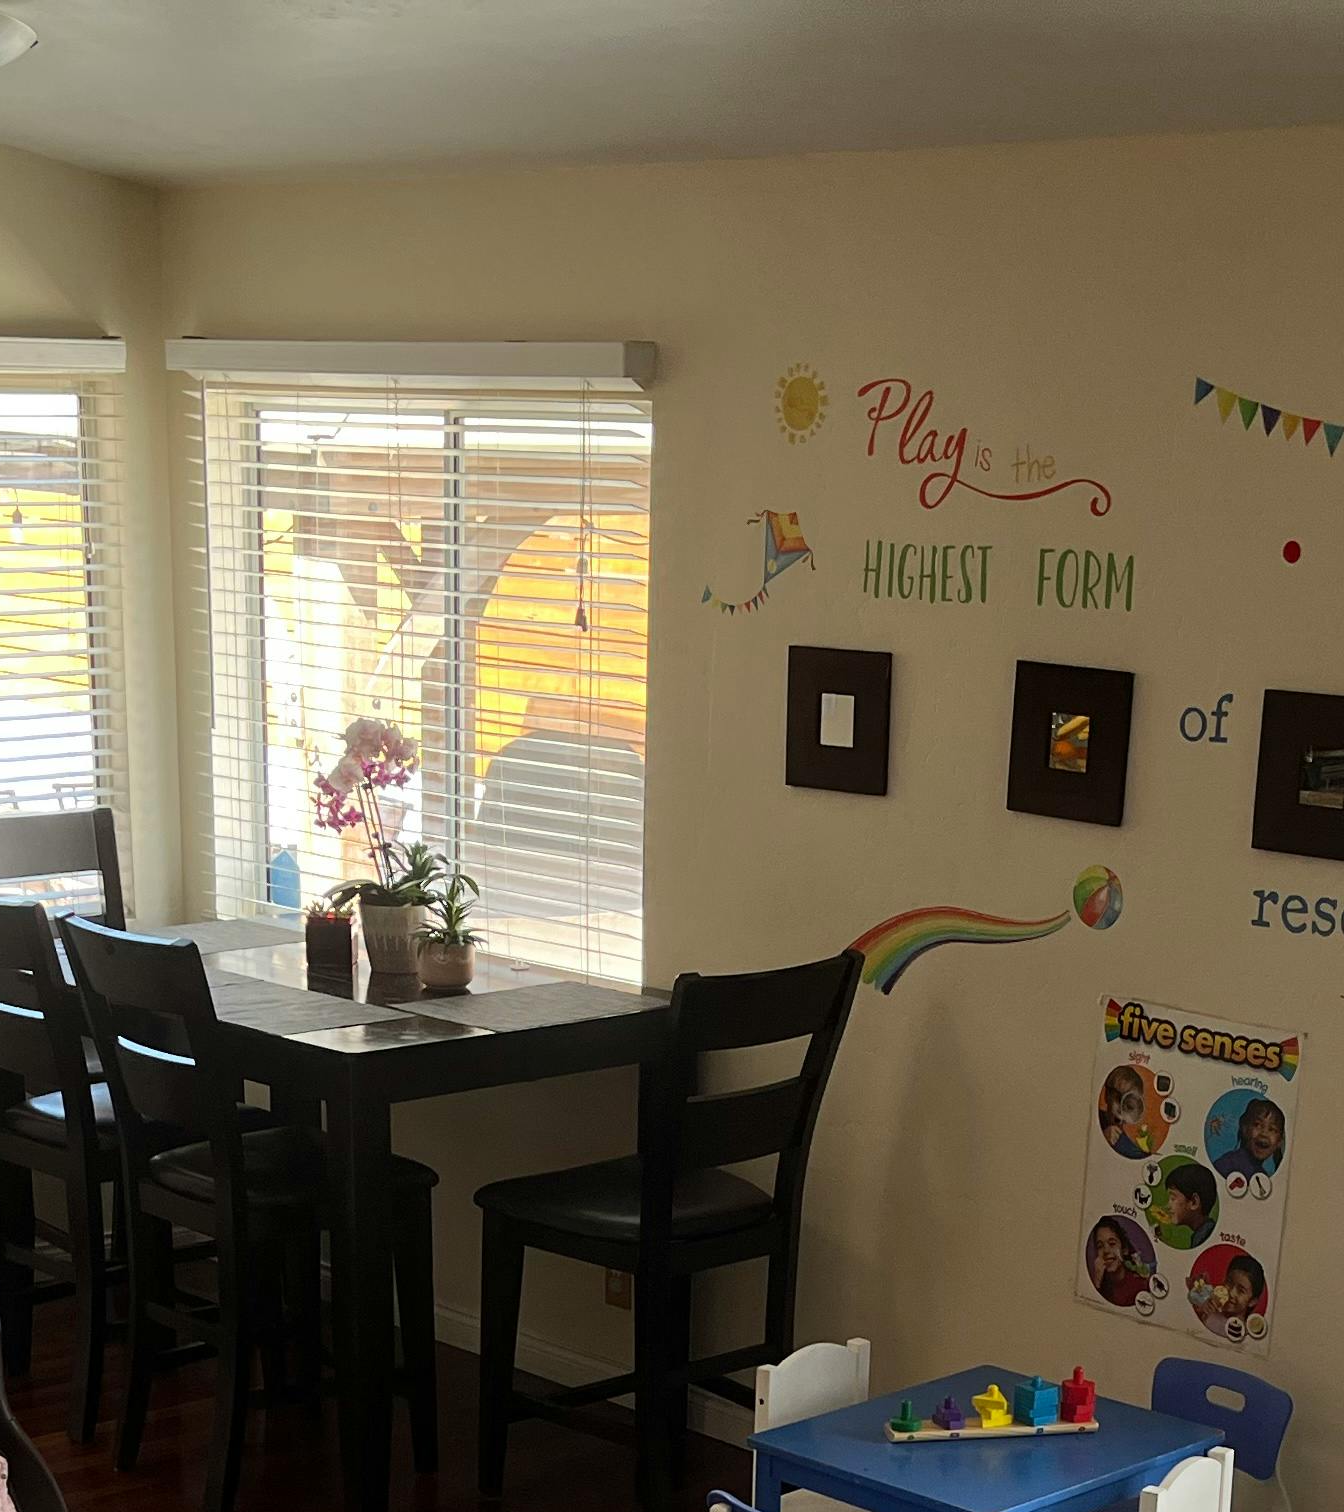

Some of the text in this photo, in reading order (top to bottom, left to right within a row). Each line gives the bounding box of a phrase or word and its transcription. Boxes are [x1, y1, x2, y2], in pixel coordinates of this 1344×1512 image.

[974, 439, 993, 472] is
[1011, 444, 1057, 483] the
[863, 540, 1136, 612] HIGHEST FORM
[1179, 693, 1234, 743] of
[1119, 1002, 1282, 1071] five senses
[1128, 1051, 1151, 1065] sight
[1231, 1075, 1270, 1094] hearing
[1112, 1203, 1139, 1218] touch
[1219, 1231, 1247, 1247] taste
